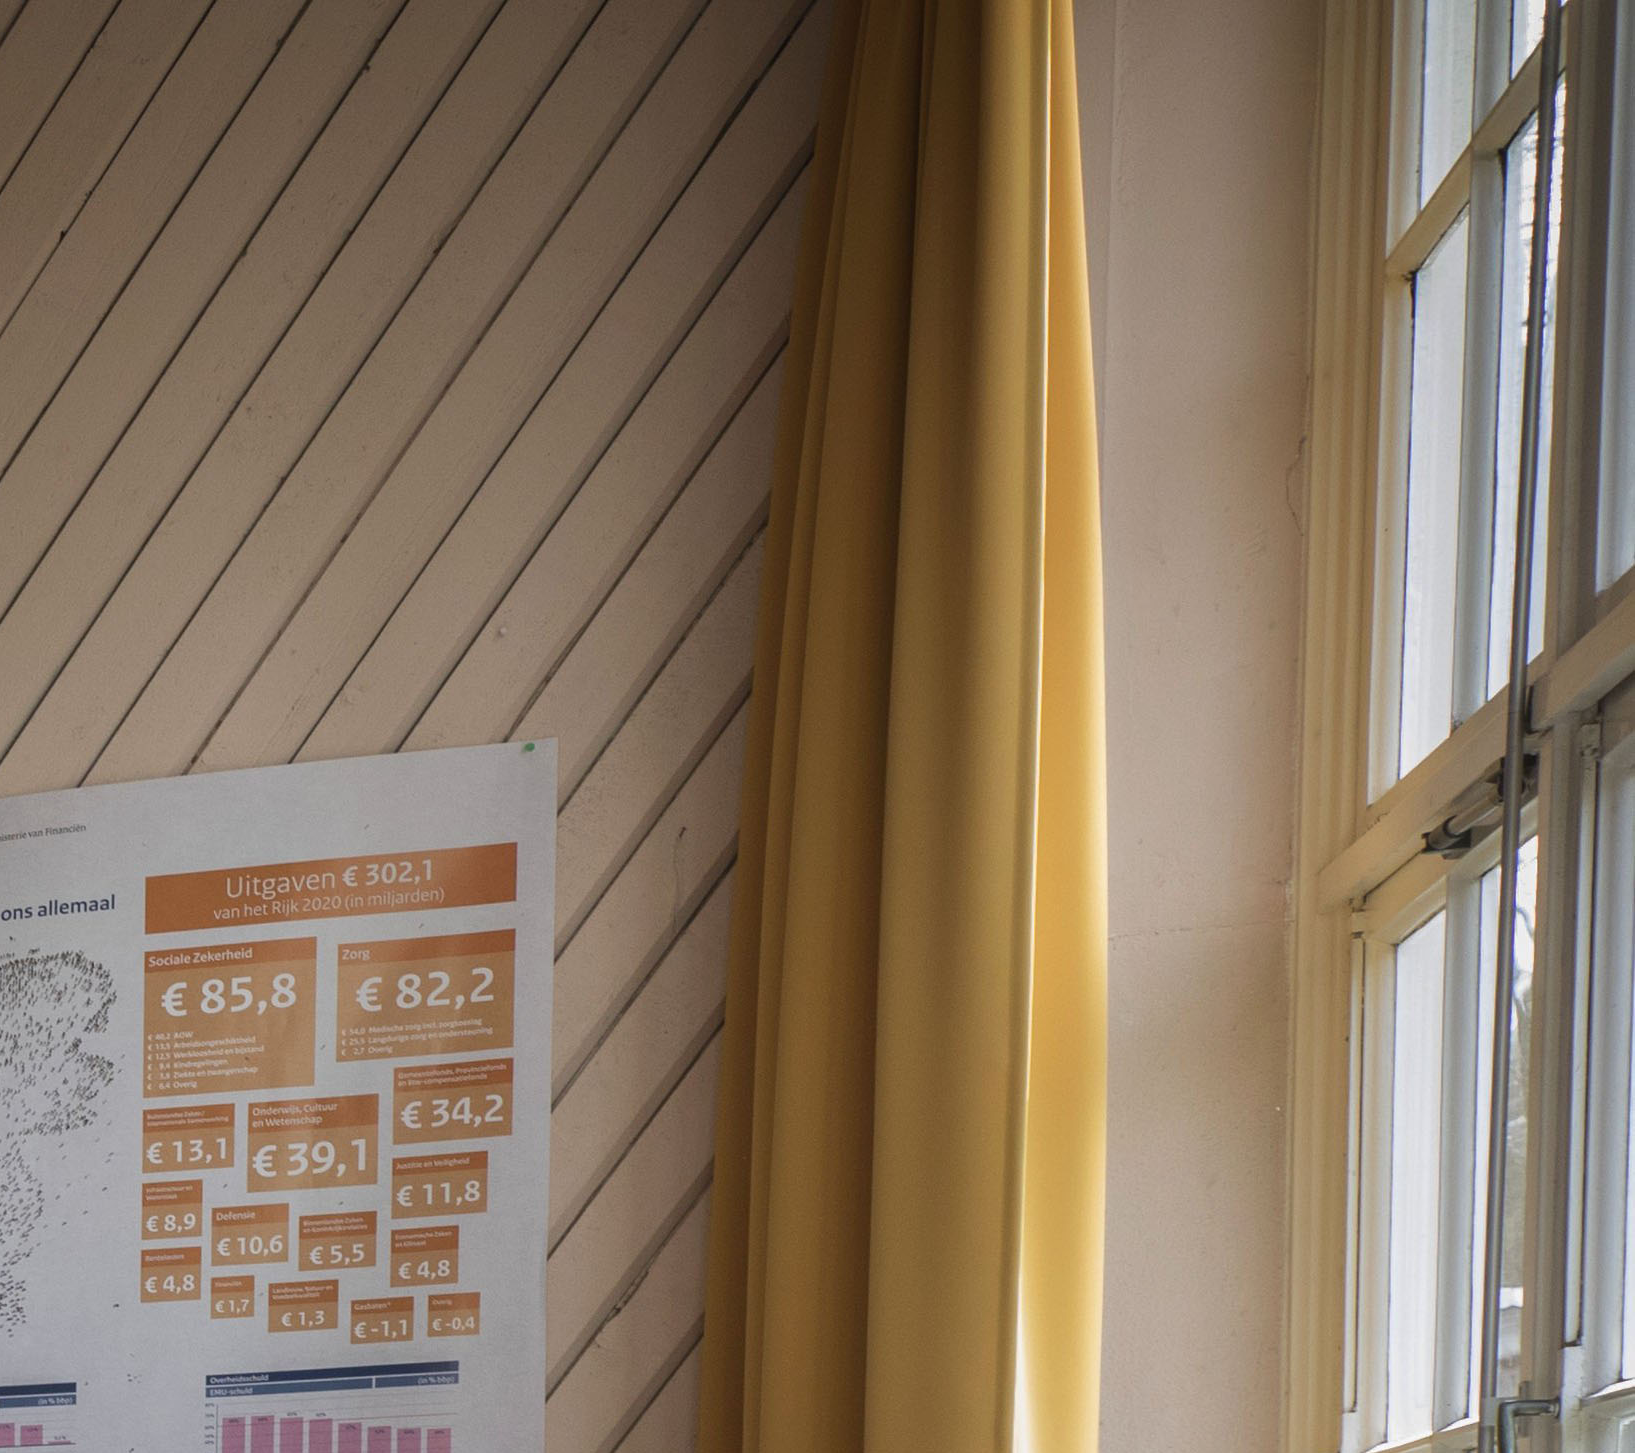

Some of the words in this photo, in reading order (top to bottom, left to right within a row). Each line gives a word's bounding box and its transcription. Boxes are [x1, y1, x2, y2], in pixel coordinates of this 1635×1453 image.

[28, 830, 44, 839] van
[45, 824, 87, 837] Financiën
[225, 869, 336, 900] Uitgaven
[341, 866, 357, 888] €
[365, 859, 433, 885] 302,1
[1, 904, 33, 921] ons
[38, 894, 115, 917] allemaal
[214, 906, 240, 920] van
[244, 904, 269, 918] het
[271, 900, 299, 920] Rijk
[304, 895, 341, 913] 2020
[345, 892, 365, 912] (in
[367, 888, 445, 909] miljarden)
[148, 954, 191, 968] Sociale
[193, 947, 253, 963] Zekerheid
[342, 948, 371, 962] Zorg
[161, 982, 187, 1017] €
[200, 973, 296, 1015] 85,8
[356, 976, 383, 1012] €
[396, 967, 495, 1009] 82,2
[303, 1103, 337, 1113] Cultuur
[401, 1101, 423, 1129] €
[431, 1094, 504, 1129] 34,2
[252, 1119, 263, 1128] en
[266, 1115, 323, 1128] Wetenschap
[146, 1142, 162, 1164] €
[172, 1138, 227, 1163] 13,1
[251, 1144, 277, 1177] €
[286, 1138, 367, 1177] 39,1
[396, 1185, 413, 1207] €
[423, 1180, 480, 1204] 11,8
[146, 1216, 158, 1232] €
[164, 1213, 196, 1232] 8,9
[216, 1211, 255, 1221] Defensie
[217, 1238, 230, 1256] €
[238, 1235, 283, 1256] 10,6
[310, 1246, 323, 1265] €
[330, 1243, 365, 1265] 5,5
